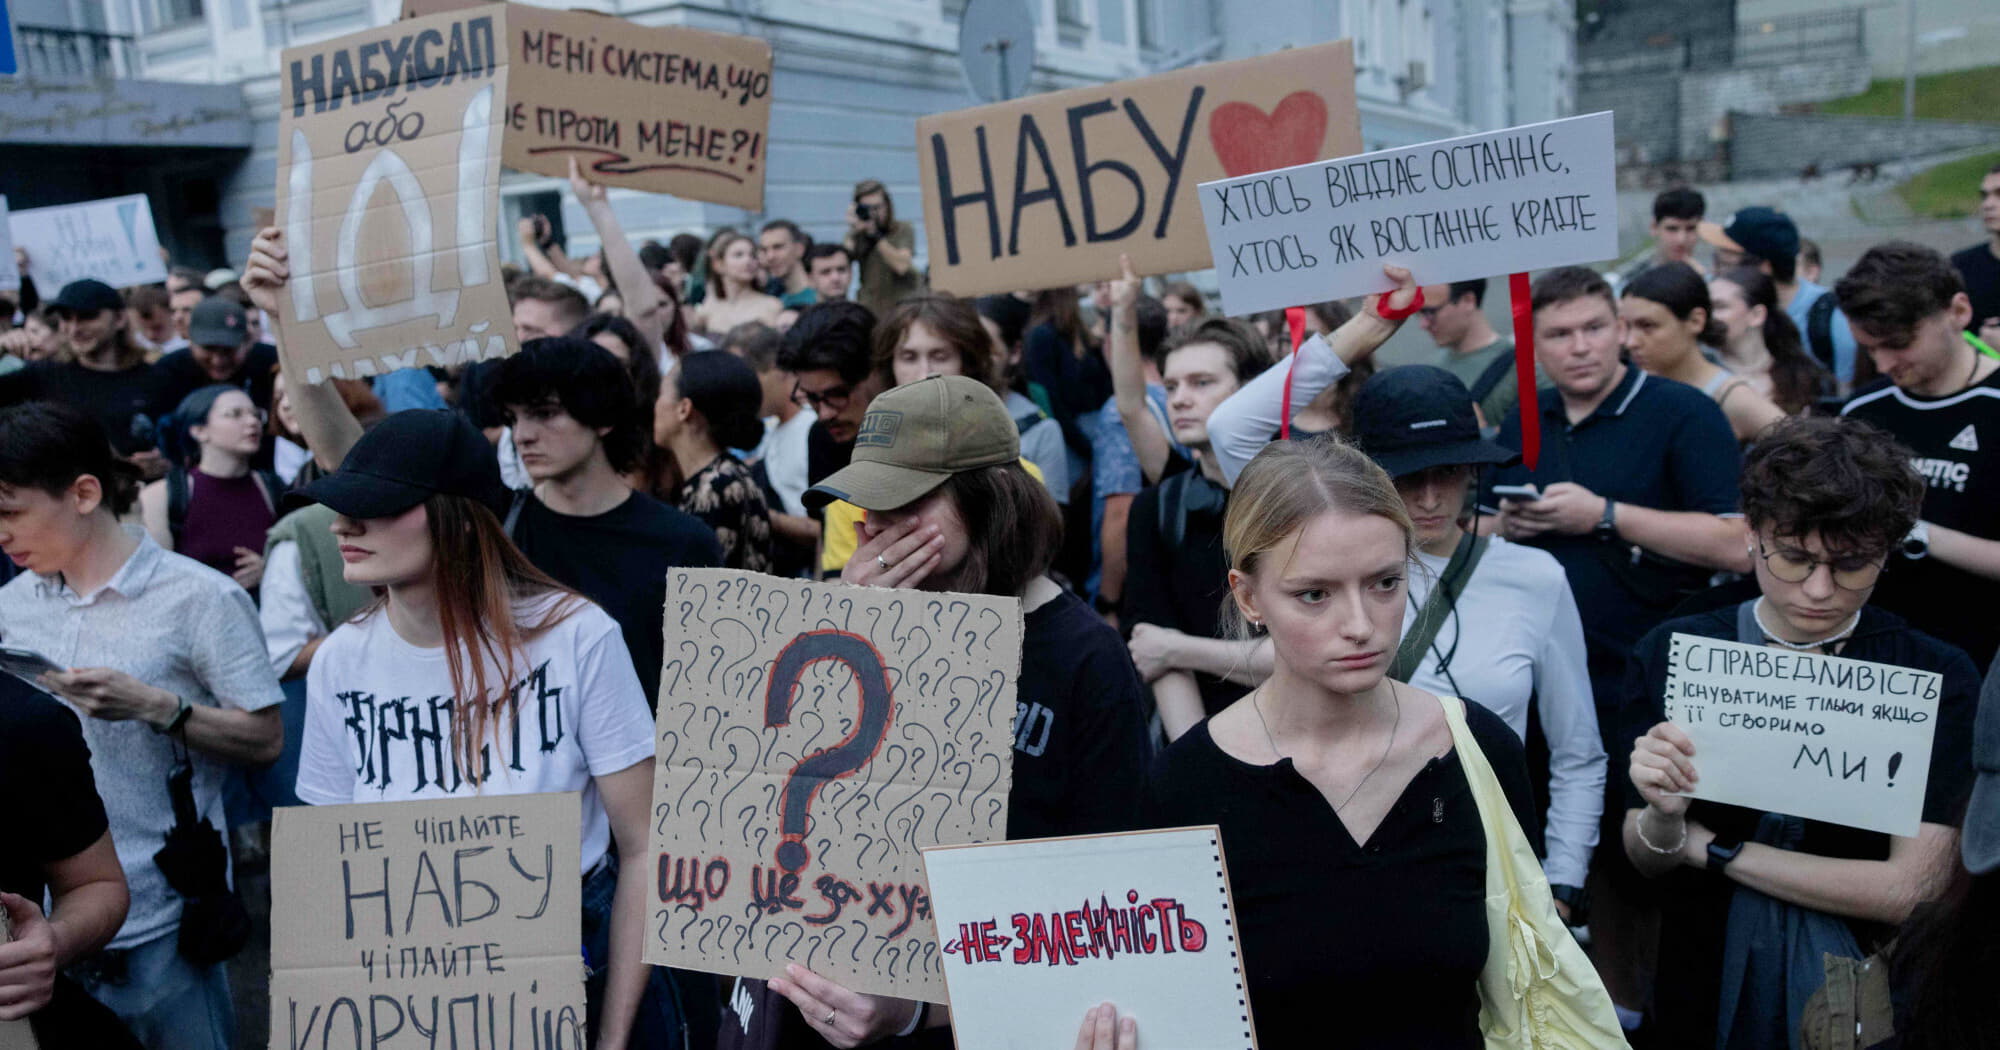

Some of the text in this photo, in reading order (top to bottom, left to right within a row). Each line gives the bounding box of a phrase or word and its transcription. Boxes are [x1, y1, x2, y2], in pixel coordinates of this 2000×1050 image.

[344, 97, 424, 154] або
[536, 106, 620, 149] ПРОТИ
[932, 86, 1205, 266] НАБУ
[1215, 133, 1571, 226] ХТОСЬ ВІДДАЄ ОСТАННЄ,
[1228, 195, 1598, 278] ХТОСЬ ЯК ВОСТАННЄ КРАДЕ
[1685, 644, 1939, 701] СПРАВЕДЛИВІСТЬ
[1683, 681, 1929, 724] ІСНУВАТИМЕ ТІЛЬКИ ЯКЩО
[1718, 711, 1826, 737] СТВОРИМО
[339, 821, 384, 855] НЕ
[341, 844, 554, 941] НАБУ
